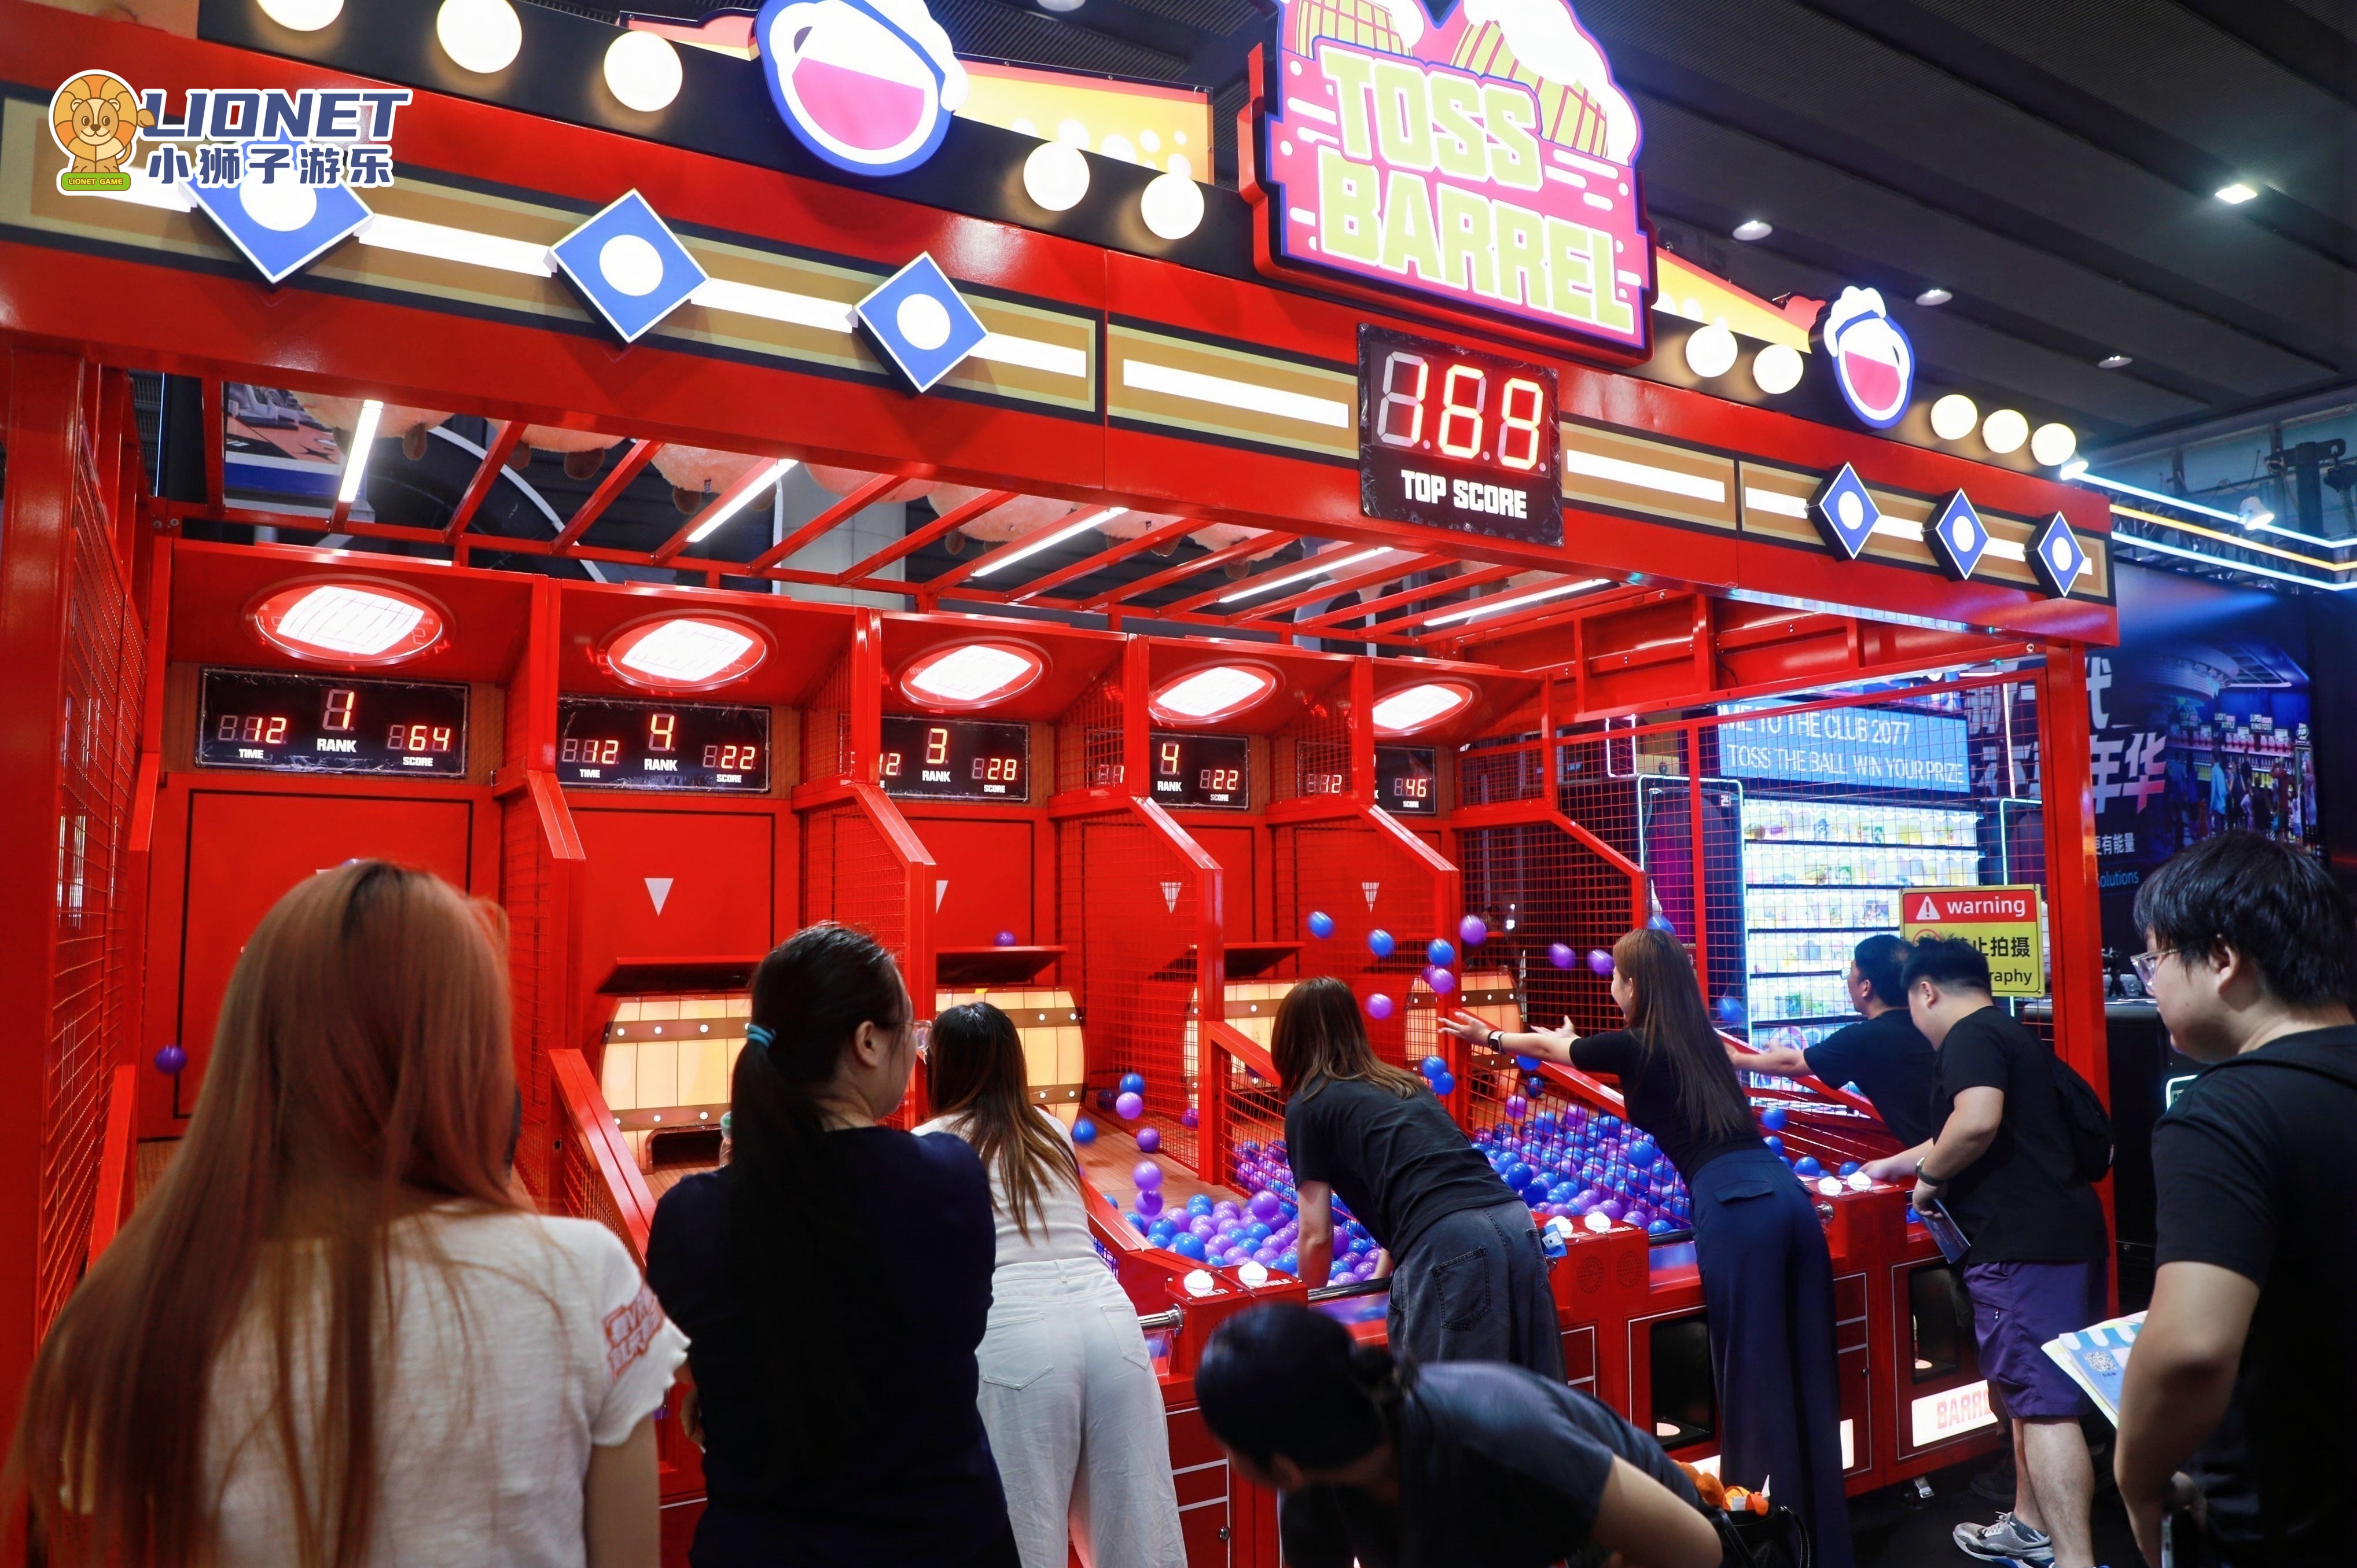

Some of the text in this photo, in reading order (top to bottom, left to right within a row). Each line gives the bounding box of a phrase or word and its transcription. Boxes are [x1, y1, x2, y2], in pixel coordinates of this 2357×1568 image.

[1322, 47, 1543, 190] TOSS
[1319, 148, 1635, 333] BARREL
[1401, 469, 1527, 520] TOP SCORE
[1718, 704, 1753, 732] ME
[1825, 714, 1867, 742] CLUB
[1871, 719, 1910, 746] 2077
[317, 738, 357, 753] RANK
[238, 748, 264, 759] TIME
[403, 756, 433, 767] SCORE
[644, 759, 678, 772] RANK
[1727, 744, 1965, 783] TOSS THE BALL WIN YOUR PRIZE
[579, 769, 601, 779] TIME
[716, 774, 742, 783] SCORE
[922, 770, 951, 782] RANK
[983, 785, 1006, 793] SCORE
[1157, 781, 1182, 792] RANK
[1210, 794, 1229, 802] SCORE
[2098, 870, 2139, 888] olutions
[1946, 896, 2025, 917] warning
[1953, 936, 2031, 958] 止拍摄
